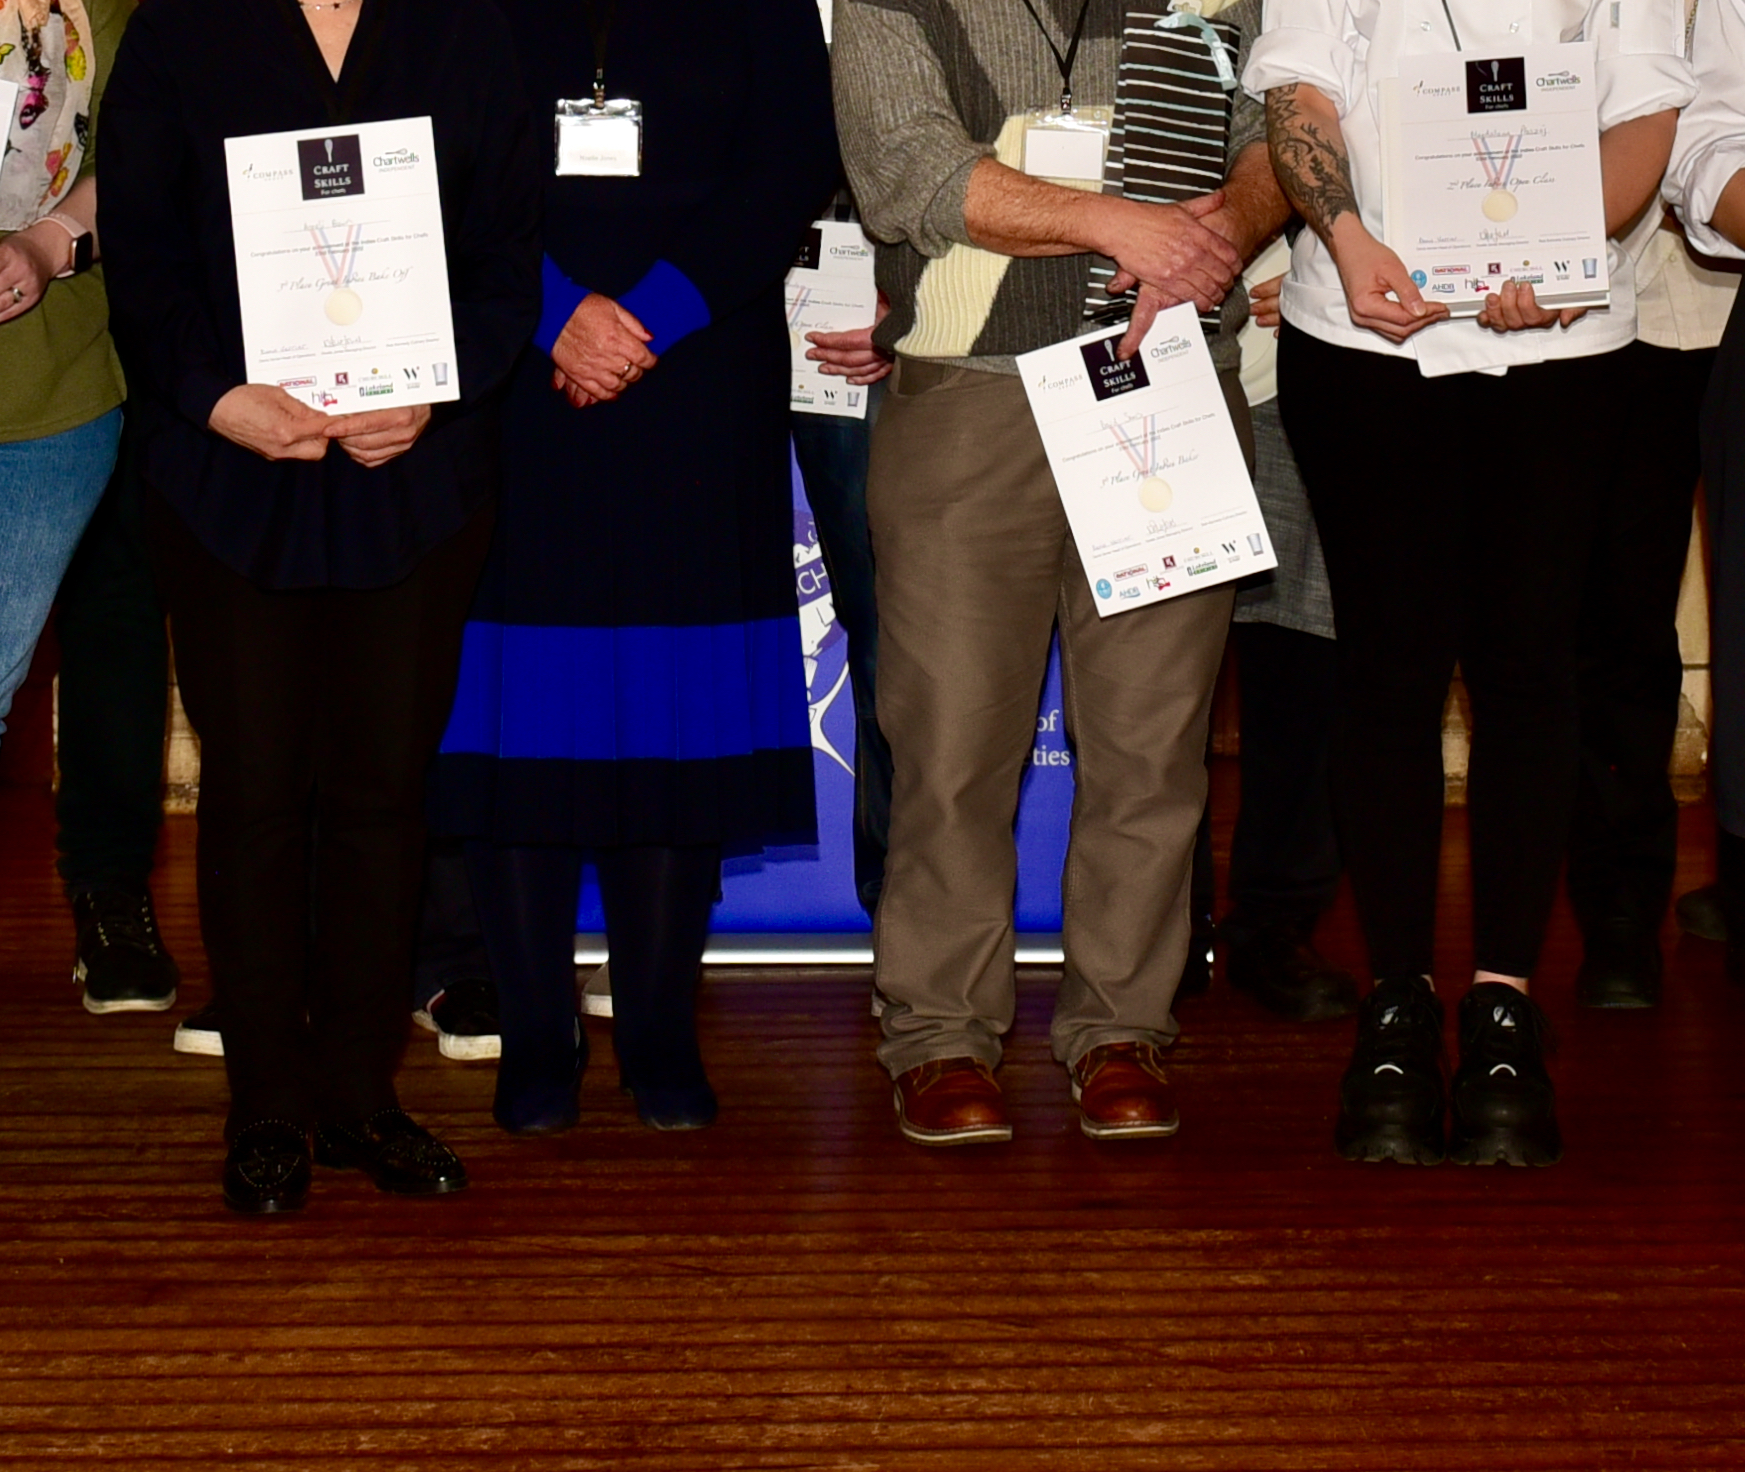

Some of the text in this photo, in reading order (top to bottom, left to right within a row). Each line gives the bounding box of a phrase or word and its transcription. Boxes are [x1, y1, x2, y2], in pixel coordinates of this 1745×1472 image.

[1536, 75, 1581, 87] Chartwells
[1423, 86, 1461, 95] COMPASS
[1479, 83, 1513, 93] CRAFT
[1479, 94, 1514, 104] SKILLS
[373, 152, 420, 168] Chartwells
[253, 169, 293, 179] COMPASS
[313, 163, 349, 175] CRAFT
[314, 177, 351, 188] SKILLS
[1459, 177, 1481, 190] Place
[1509, 178, 1530, 193] Open
[1532, 173, 1555, 184] Class
[250, 248, 291, 258] Congratulations
[1150, 339, 1191, 358] Chartwells
[1100, 360, 1131, 375] CRAFT
[1048, 374, 1083, 389] COMPASS
[1103, 372, 1136, 388] SKILLS
[1037, 709, 1059, 731] of
[1032, 745, 1070, 766] ties
